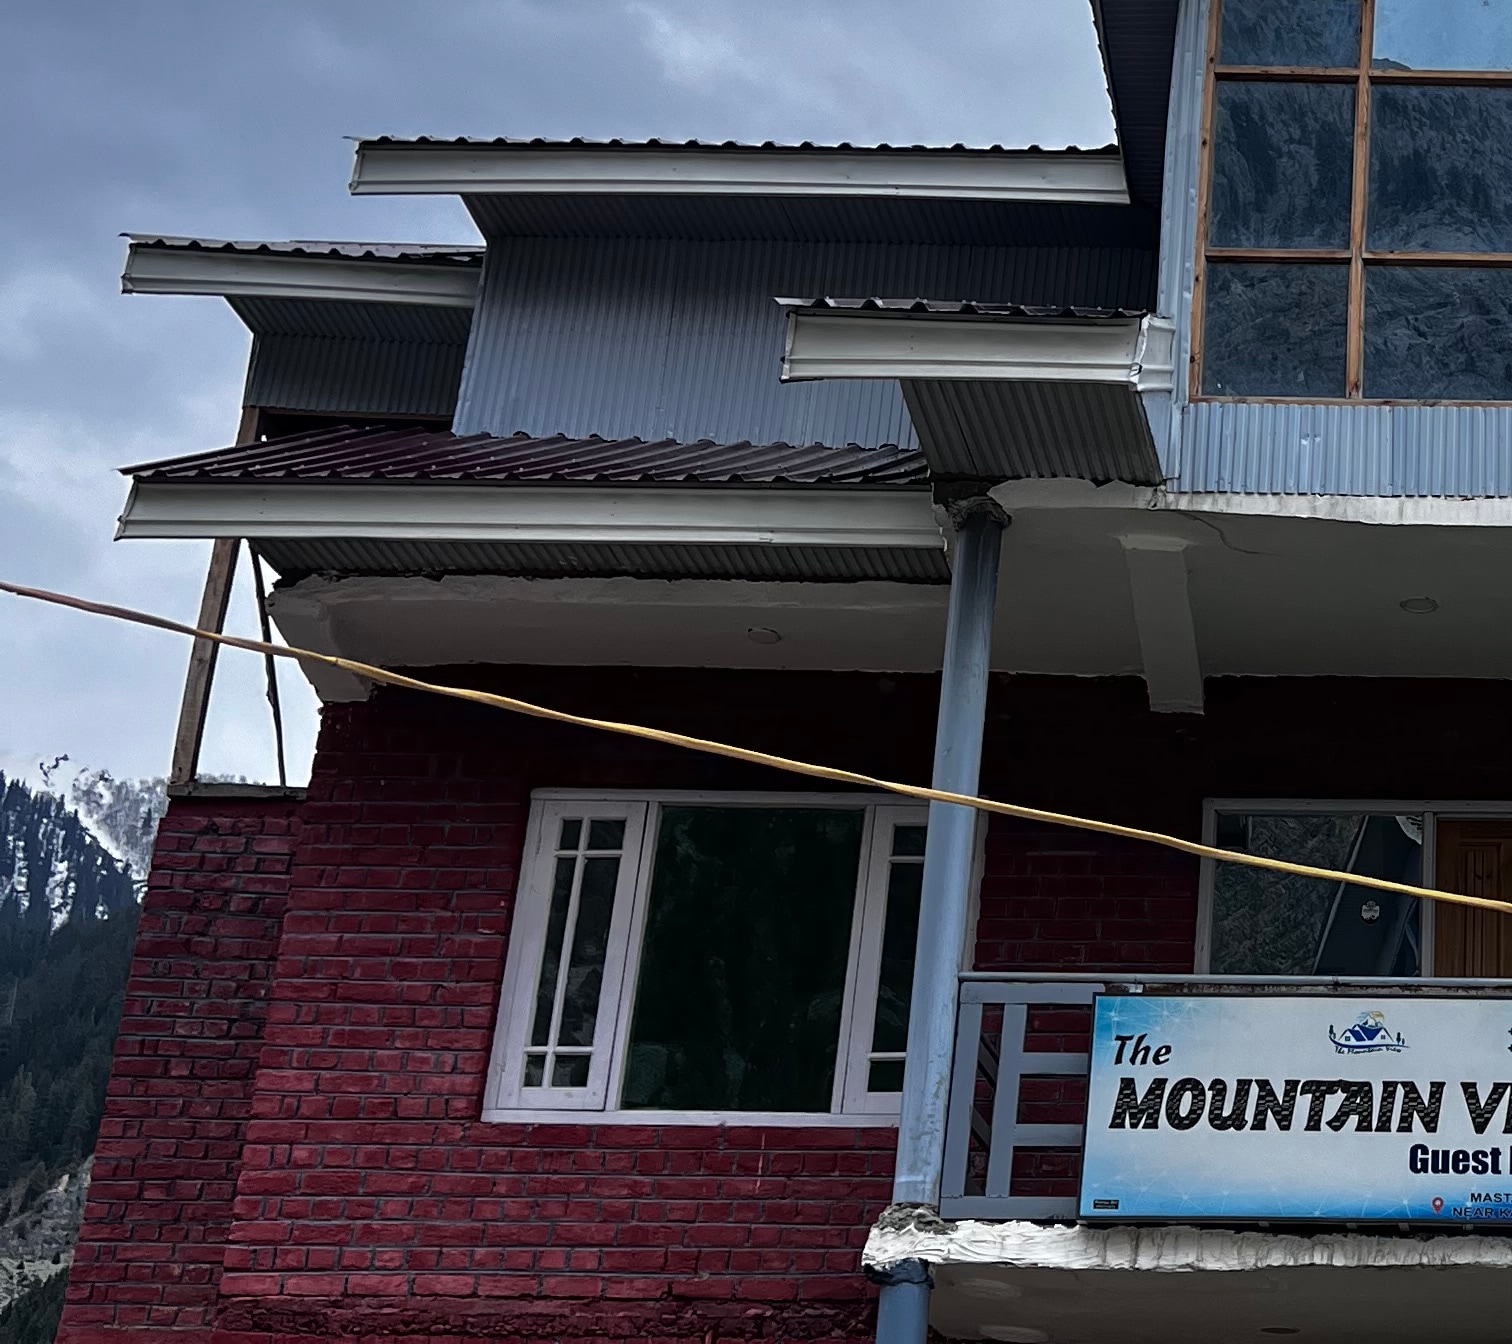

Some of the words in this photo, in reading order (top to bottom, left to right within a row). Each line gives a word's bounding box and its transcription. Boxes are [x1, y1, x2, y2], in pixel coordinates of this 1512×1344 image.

[1113, 1033, 1172, 1066] The
[1108, 1077, 1446, 1133] MOUNTAIN
[1409, 1143, 1502, 1175] Guest
[1452, 1206, 1496, 1218] NEAR
